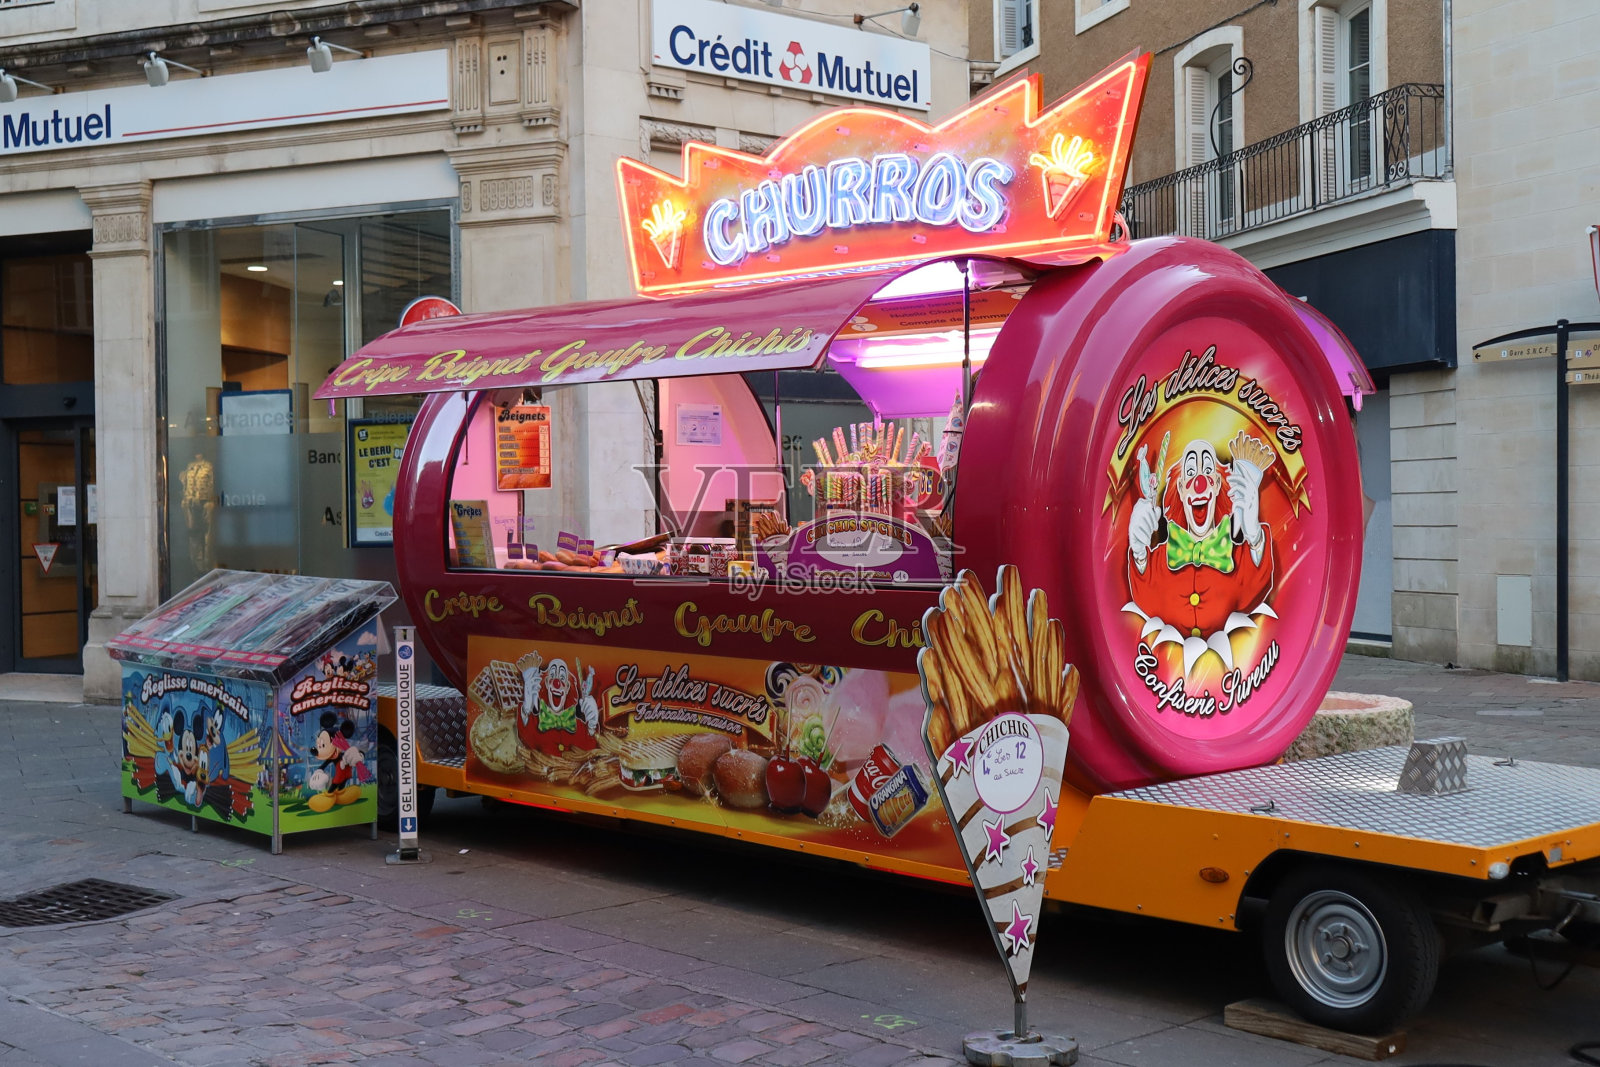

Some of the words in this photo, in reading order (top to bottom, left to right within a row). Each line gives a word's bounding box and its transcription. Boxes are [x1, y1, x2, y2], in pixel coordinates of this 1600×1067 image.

[669, 25, 773, 78] Crédit
[817, 53, 919, 103] Mutuel
[3, 104, 112, 149] Mutuel
[703, 152, 1014, 266] CHURROS
[899, 317, 948, 327] Compote
[416, 349, 543, 387] Beignet
[540, 339, 668, 384] Gaufre
[675, 326, 814, 364] Chichis
[498, 409, 546, 424] Beignets
[1118, 375, 1159, 458] Les
[1165, 344, 1240, 400] délices
[1238, 379, 1303, 453] sucrés
[424, 588, 504, 623] Crêpe
[528, 592, 645, 638] Beignet
[674, 601, 818, 646] Gaufre
[611, 663, 646, 704] Les
[651, 664, 709, 705] délices
[711, 683, 769, 724] sucrés
[1134, 641, 1216, 717] Confiserie
[1218, 640, 1280, 713] Sureau
[398, 663, 412, 787] HYDROALCOOLIQUE
[634, 702, 698, 725] Fabrication
[700, 713, 743, 735] maison
[979, 719, 1030, 755] CHICHIS
[1015, 741, 1027, 759] 12
[402, 790, 412, 813] GEL
[871, 770, 908, 810] ORANGINA
